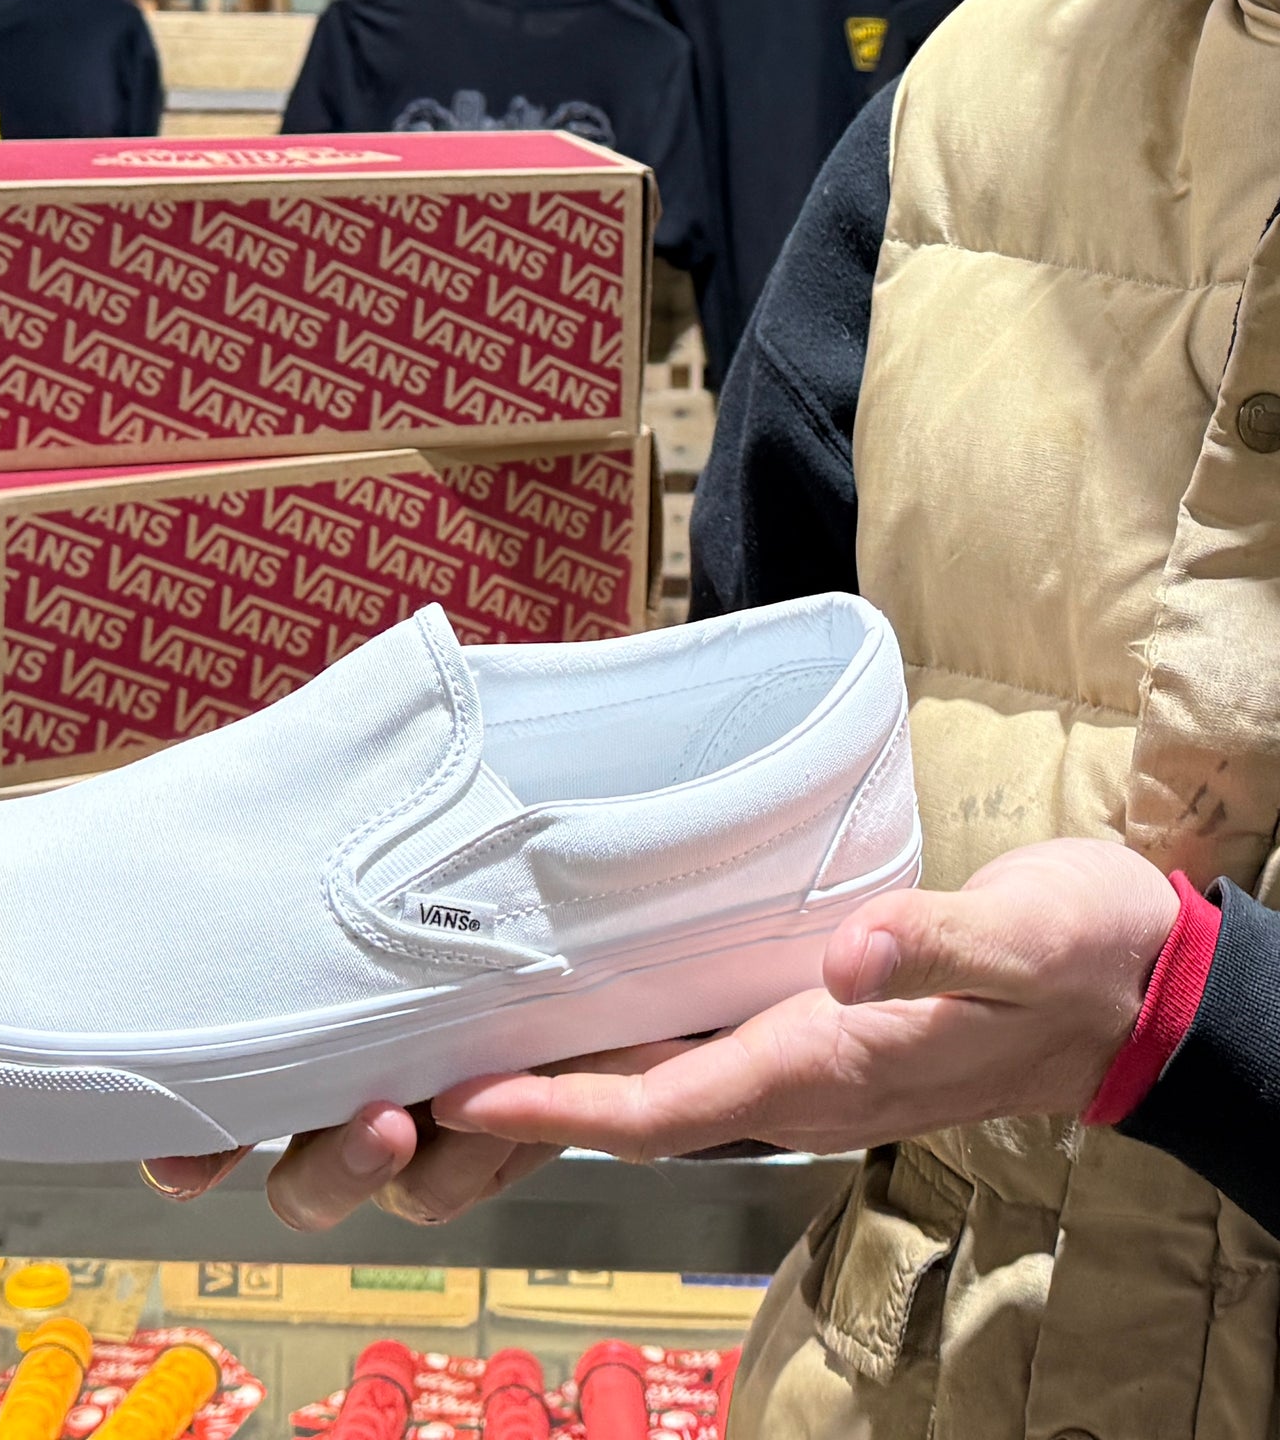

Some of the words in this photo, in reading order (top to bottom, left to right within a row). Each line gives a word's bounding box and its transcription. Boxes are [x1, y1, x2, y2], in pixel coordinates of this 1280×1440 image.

[455, 206, 554, 280] VANS
[529, 193, 624, 258] VANS
[28, 246, 139, 324] VANS
[146, 296, 253, 372] VANS
[260, 344, 364, 418] VANS
[111, 223, 220, 300] VANS
[226, 273, 331, 348] VANS
[337, 320, 439, 394] VANS
[192, 201, 298, 277] VANS
[304, 250, 407, 325] VANS
[413, 298, 513, 371] VANS
[519, 344, 616, 416] VANS
[380, 228, 481, 302] VANS
[487, 275, 585, 348] VANS
[64, 320, 174, 396] VANS
[180, 368, 287, 436] VANS
[262, 488, 362, 557] VANS
[367, 526, 462, 595] VANS
[467, 565, 558, 632] VANS
[438, 498, 530, 566] VANS
[534, 537, 623, 604] VANS
[506, 471, 595, 538] VANS
[74, 500, 180, 546] ANS
[186, 515, 288, 586] VANS
[294, 556, 392, 625] VANS
[108, 545, 213, 617] VANS
[219, 586, 320, 656] VANS
[26, 576, 135, 649] VANS
[141, 616, 246, 688] VANS
[61, 648, 168, 720] VANS
[3, 691, 89, 754] ANS
